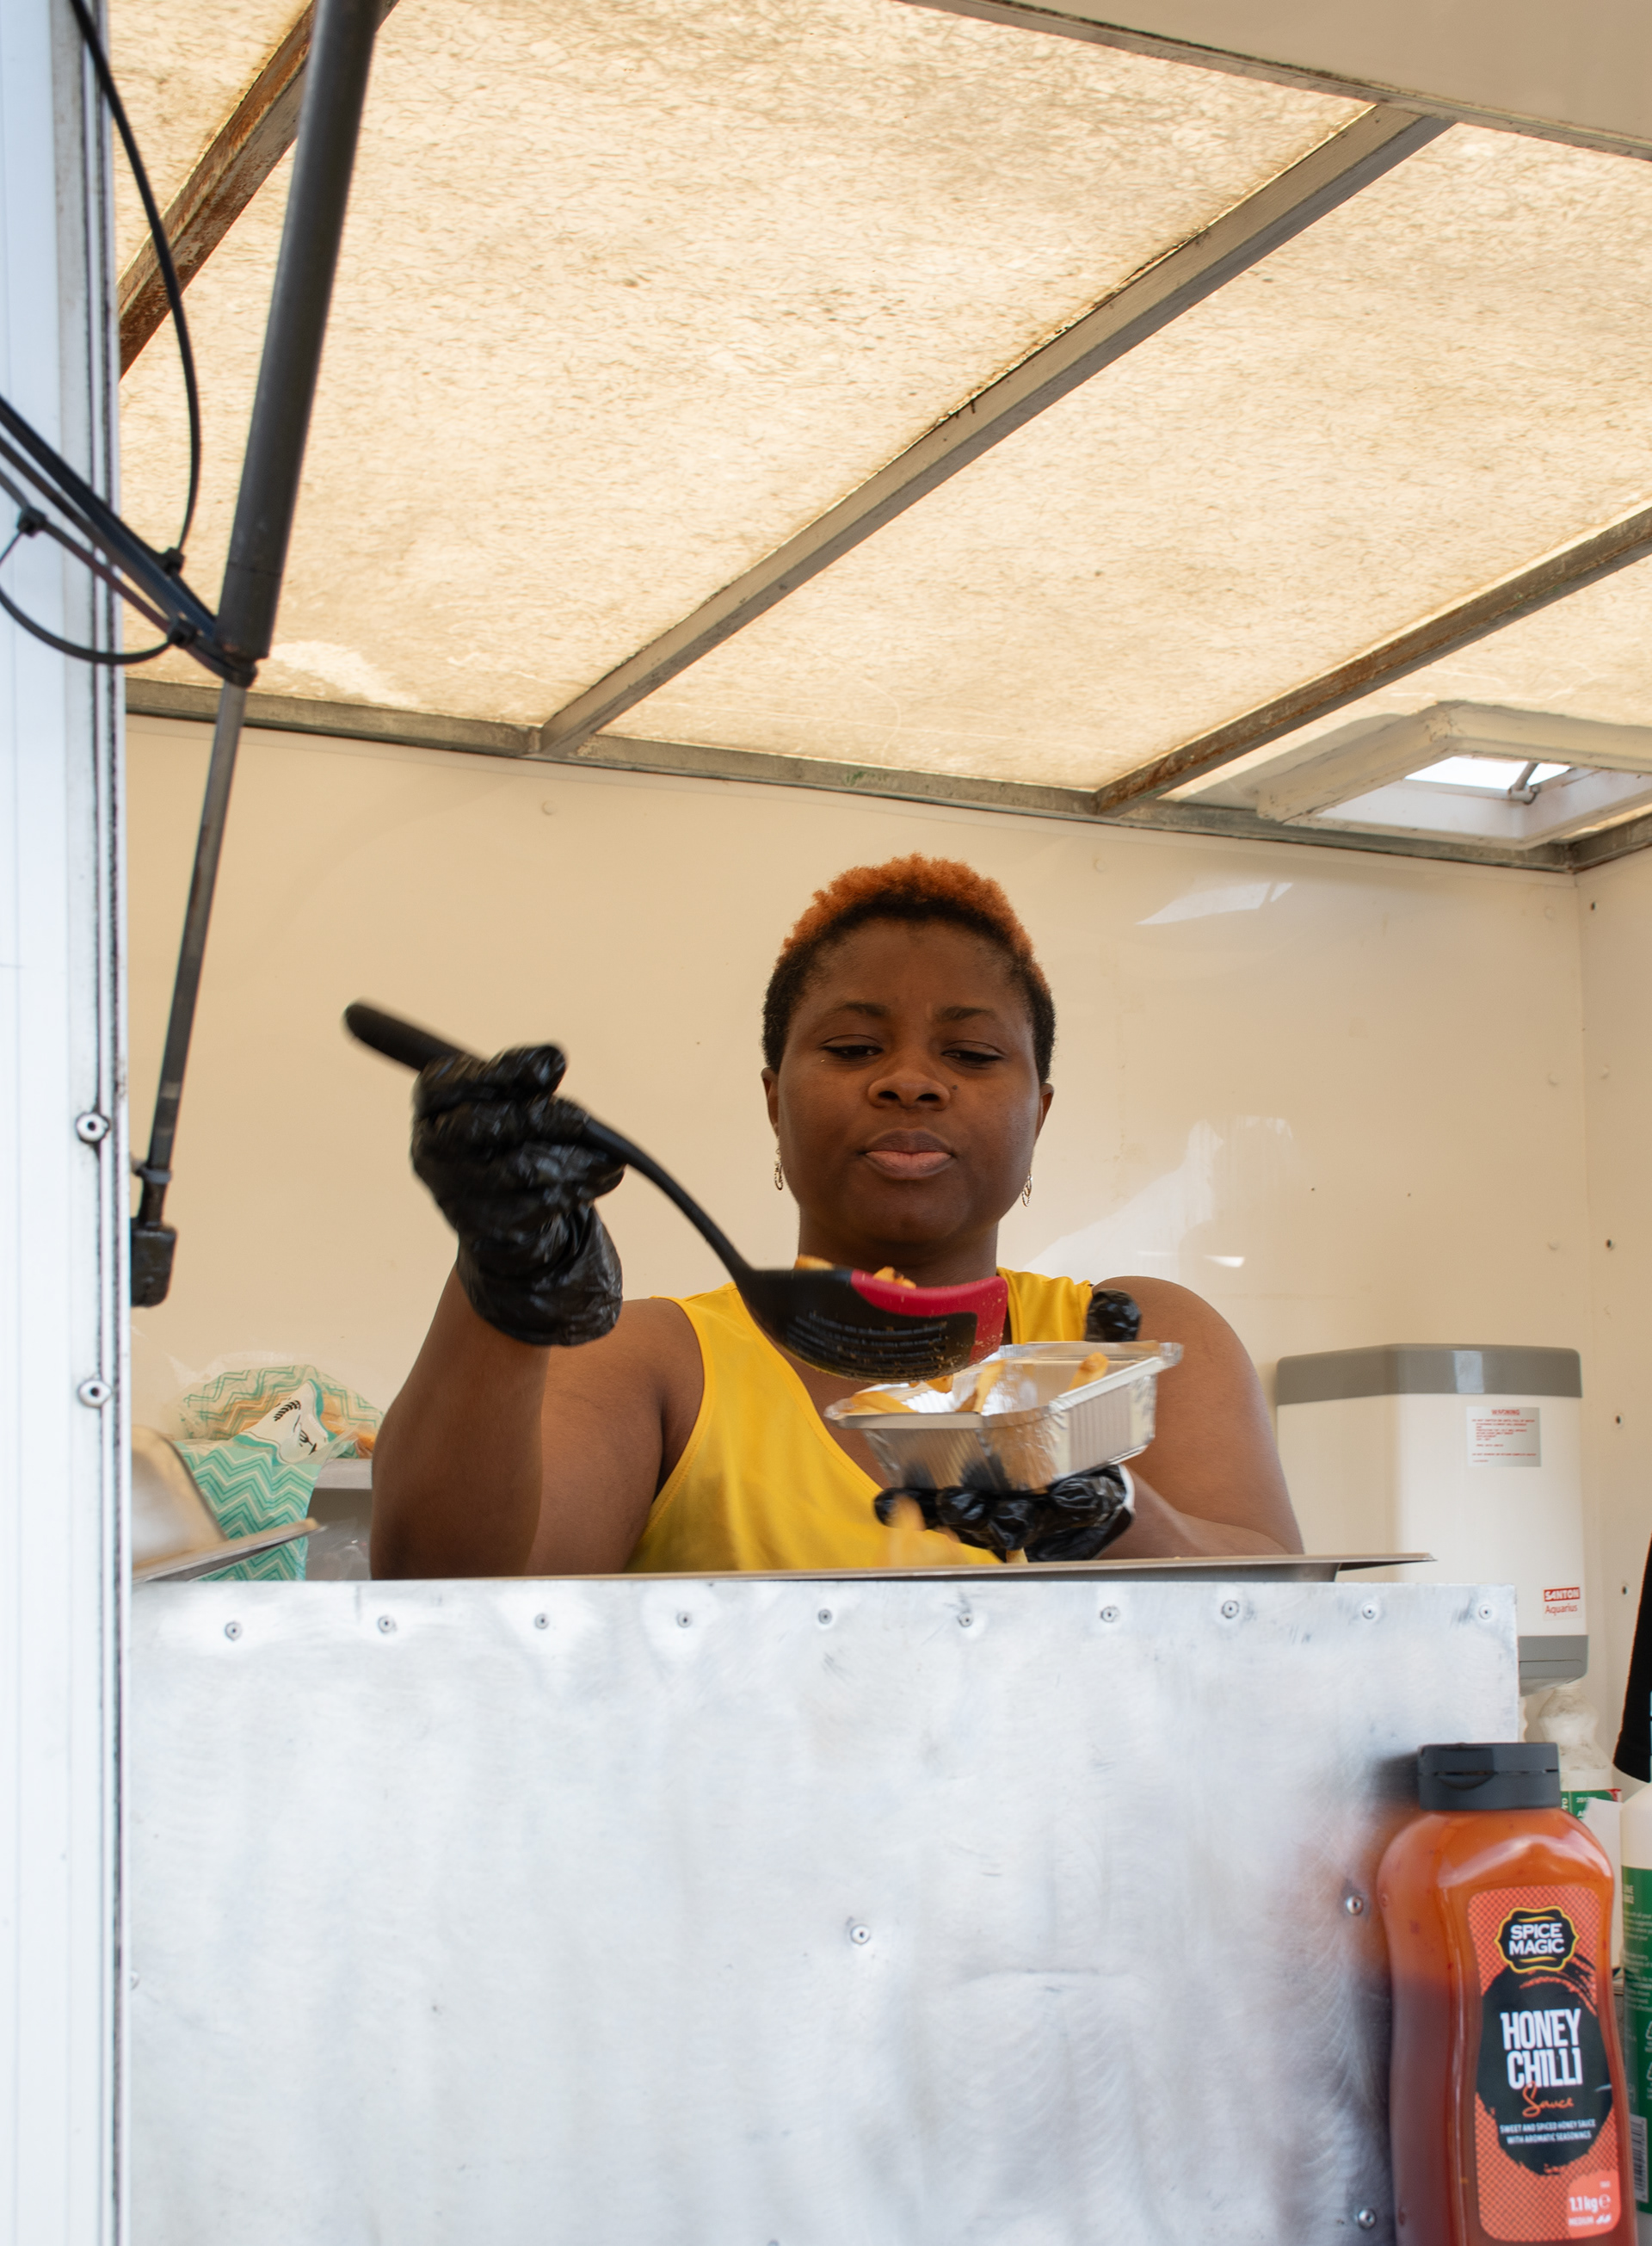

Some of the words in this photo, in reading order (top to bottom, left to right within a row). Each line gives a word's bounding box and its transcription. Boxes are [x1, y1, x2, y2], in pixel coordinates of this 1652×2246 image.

[1544, 1589, 1579, 1601] SANTON
[1544, 1603, 1578, 1616] Aquarius
[1510, 1922, 1563, 1940] SPICE
[1508, 1938, 1565, 1955] MAGIC
[1500, 2008, 1581, 2050] HONEY
[1507, 2047, 1583, 2089] CHILLI
[1522, 2081, 1574, 2118] Sauce
[1499, 2124, 1522, 2134] SWEET
[1522, 2123, 1536, 2132] AND
[1536, 2121, 1557, 2132] SPICED
[1557, 2120, 1578, 2130] HONEY
[1577, 2118, 1596, 2128] SAUCE
